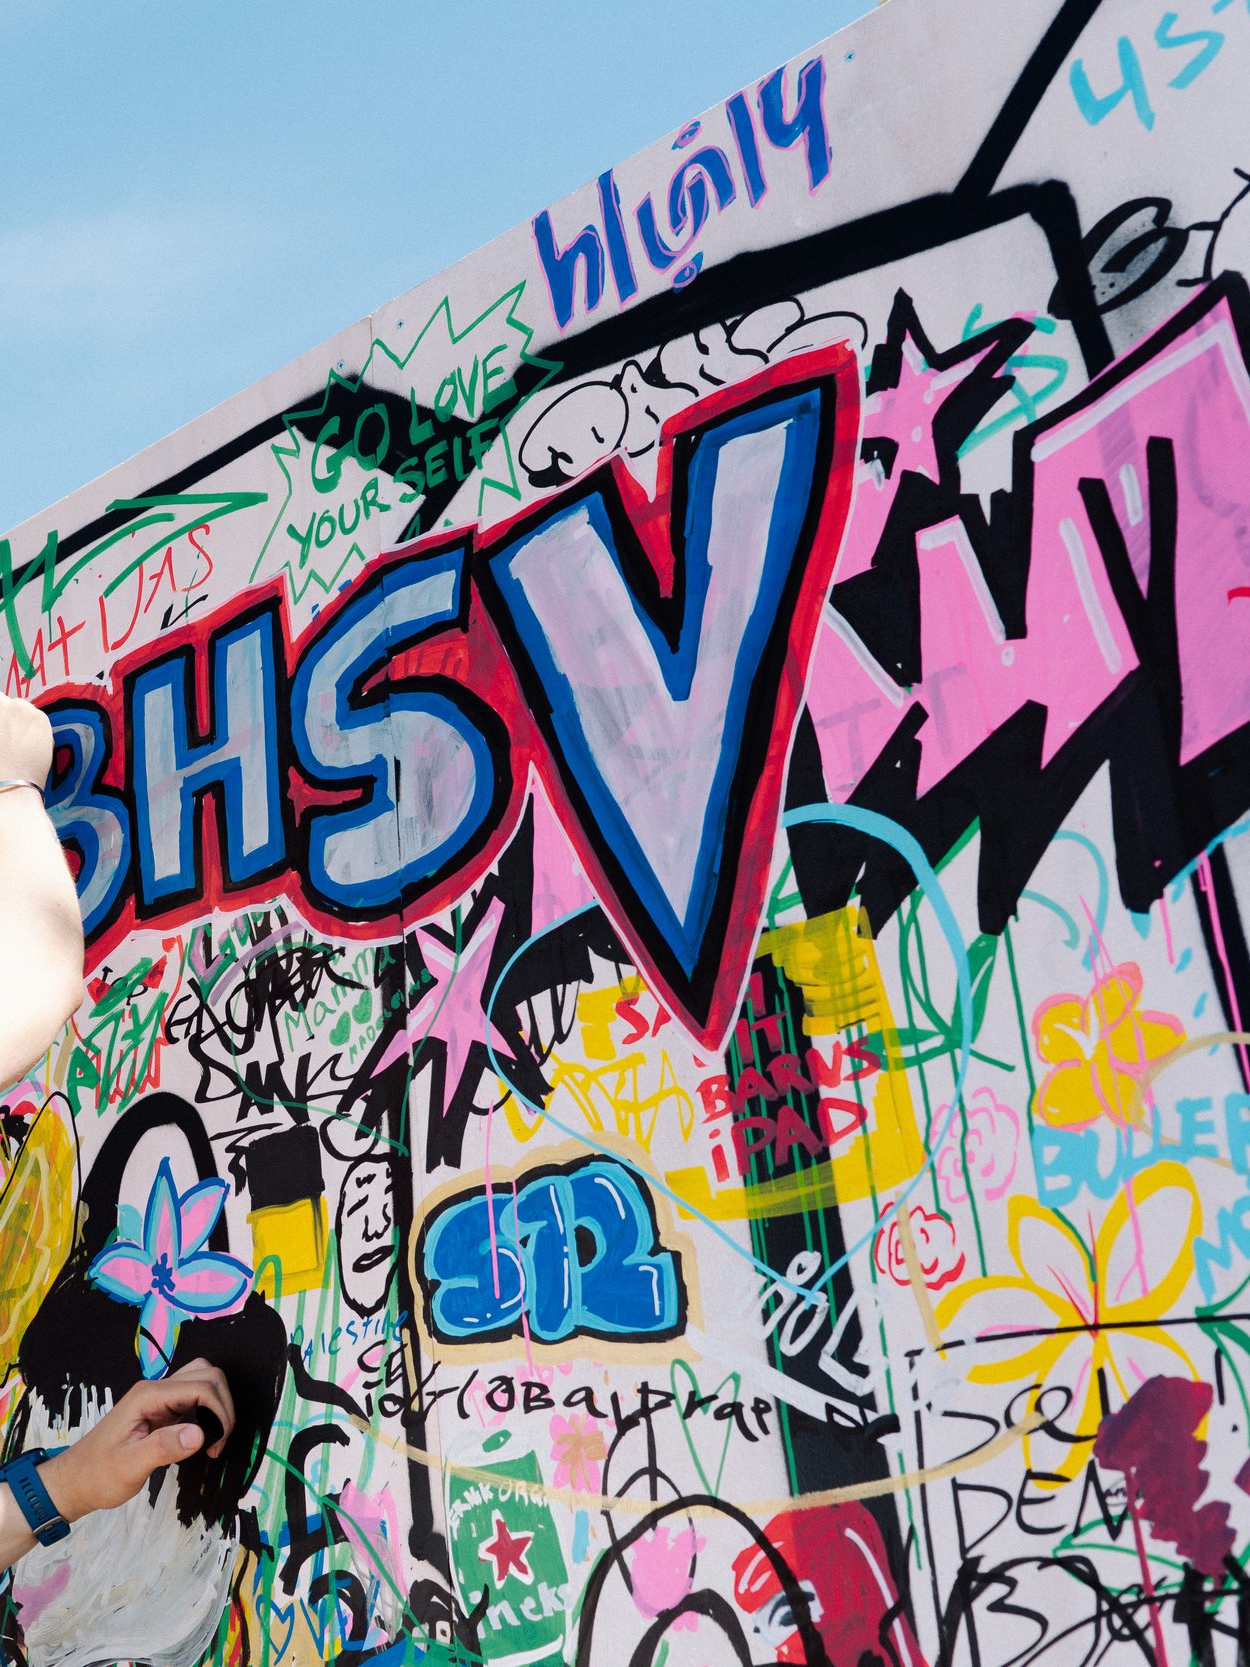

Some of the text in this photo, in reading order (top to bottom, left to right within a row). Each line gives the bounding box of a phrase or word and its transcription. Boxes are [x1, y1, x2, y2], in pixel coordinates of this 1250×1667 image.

[309, 344, 517, 494] GO LOVE
[288, 419, 501, 568] YOUR SELF
[696, 1036, 882, 1124] BARNS
[708, 1097, 868, 1183] iPAD
